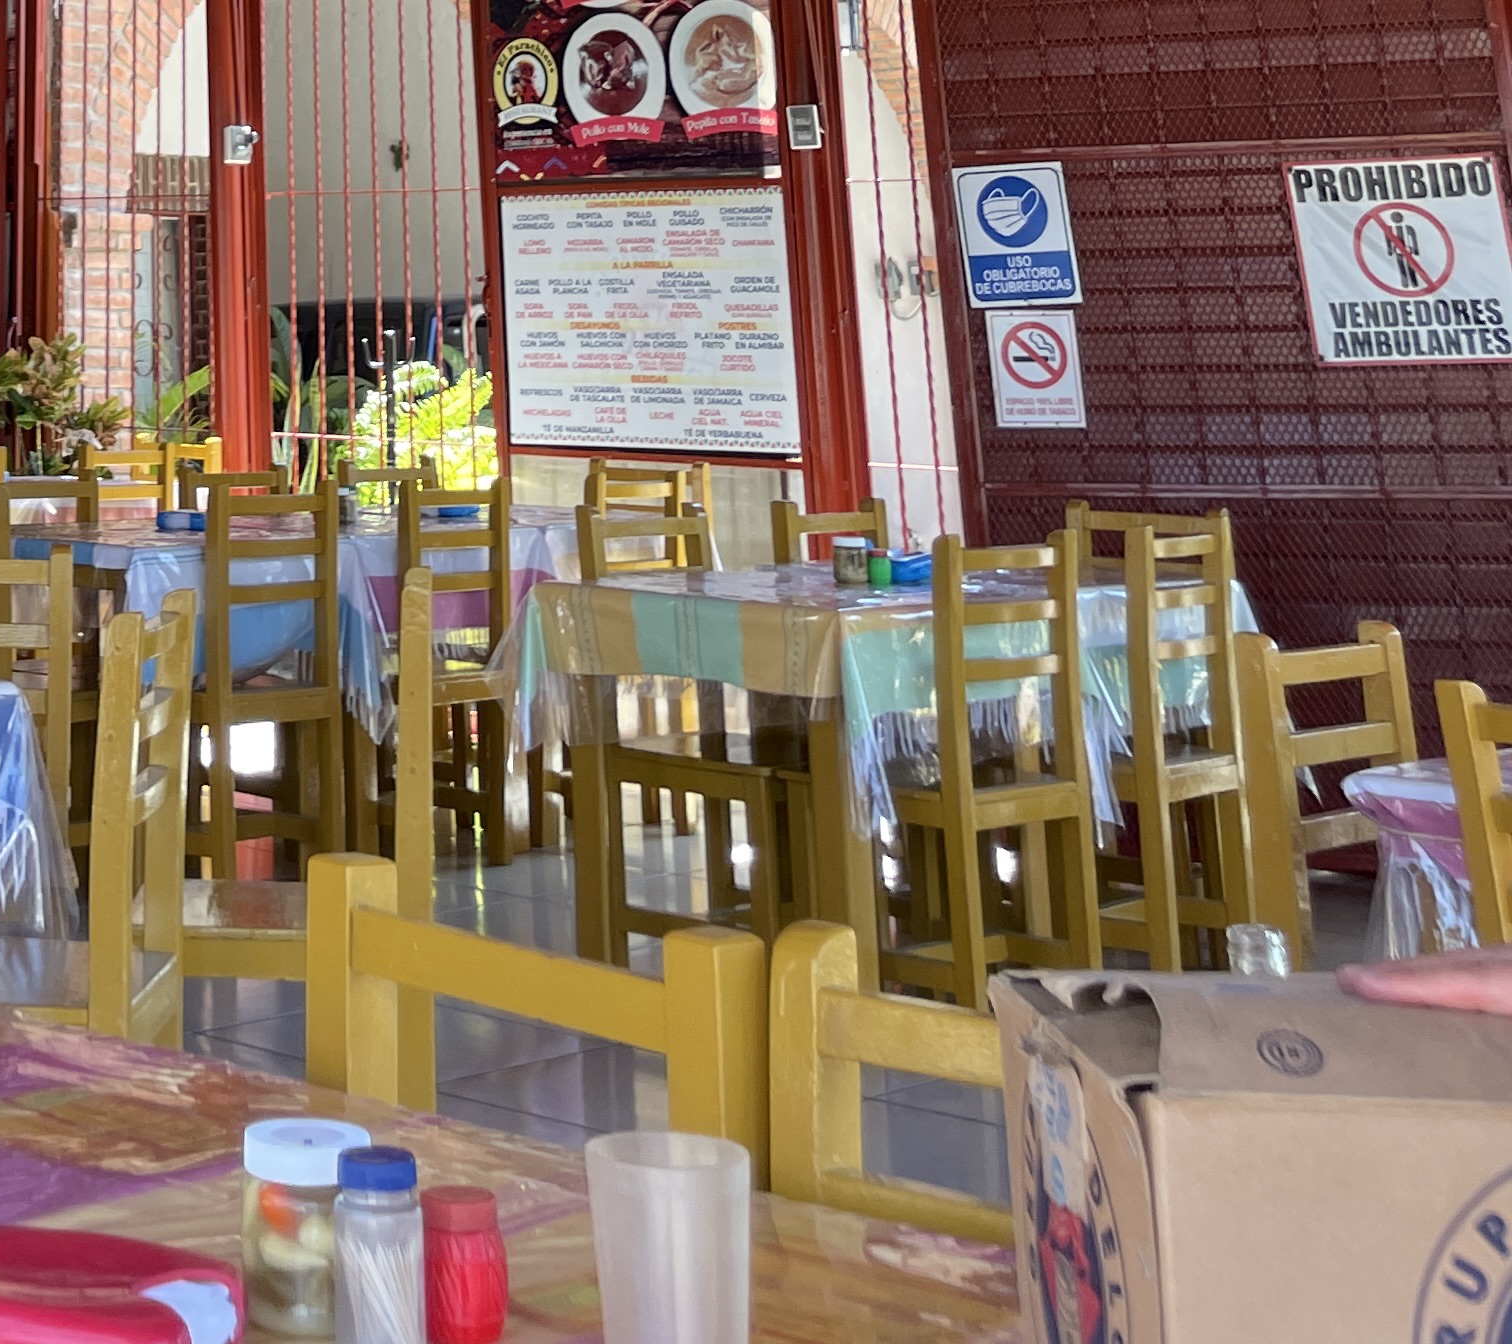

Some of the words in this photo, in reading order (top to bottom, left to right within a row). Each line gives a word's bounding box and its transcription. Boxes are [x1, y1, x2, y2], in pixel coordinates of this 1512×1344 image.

[1292, 160, 1492, 203] PROHIBIDO
[1007, 255, 1032, 267] USO
[982, 266, 1060, 281] OBLIGATORIO
[976, 283, 992, 294] DE
[993, 278, 1072, 293] CUBREBOCAS
[1329, 298, 1503, 329] VENDEDORES
[1332, 327, 1511, 359] AMBULANTES
[749, 393, 787, 402] CERVEZA
